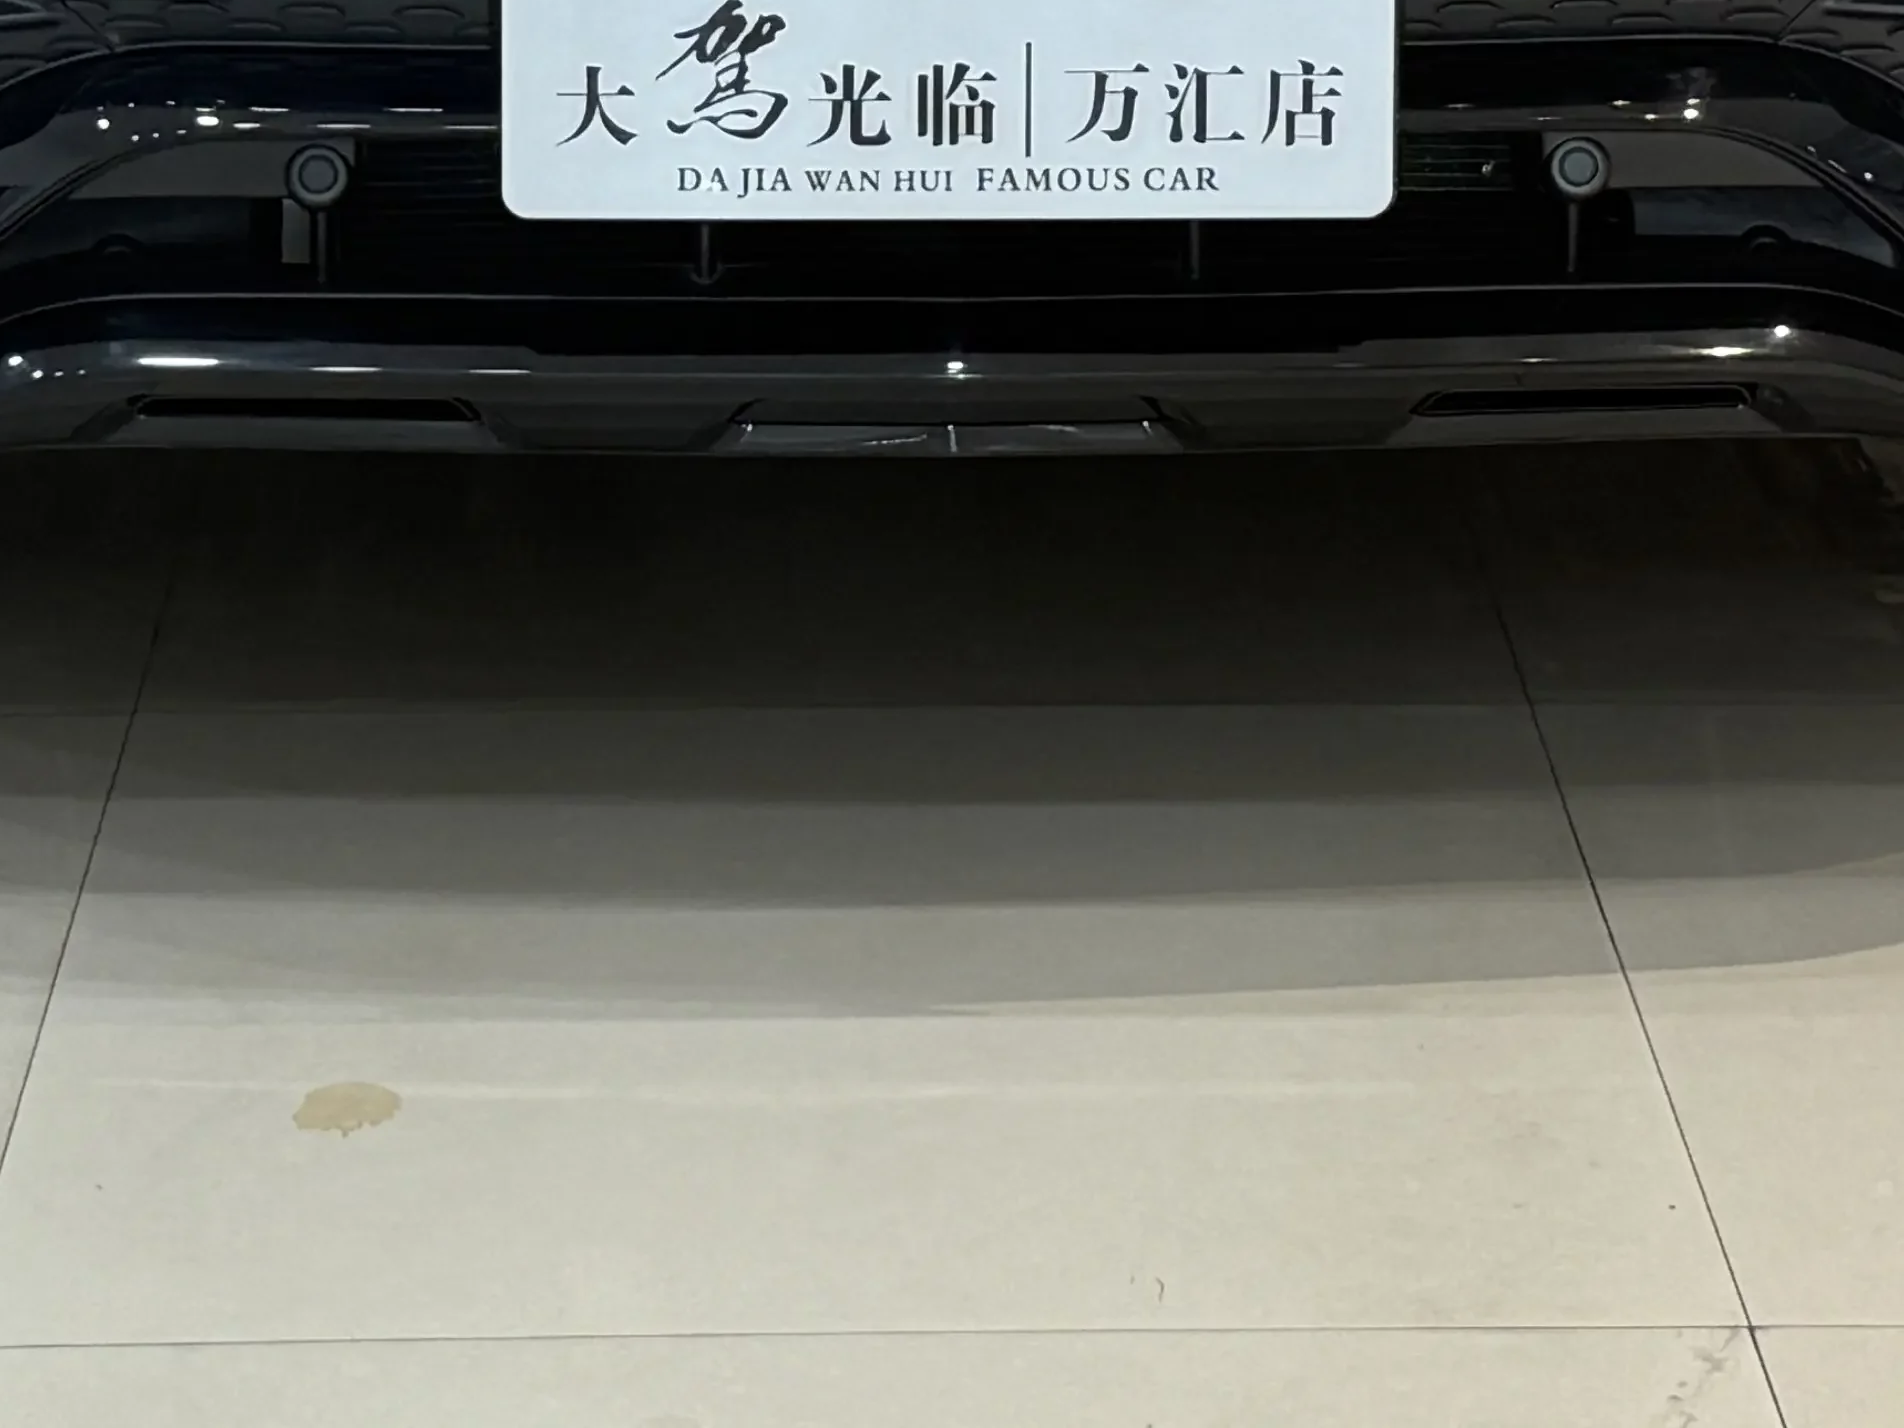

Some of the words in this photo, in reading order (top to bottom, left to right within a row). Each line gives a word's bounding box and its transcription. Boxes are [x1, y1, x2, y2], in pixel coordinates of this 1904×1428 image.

[558, 0, 996, 146] 大驾光临
[1068, 60, 1343, 146] 万汇店
[805, 171, 879, 191] WAN
[895, 171, 951, 191] HUI
[978, 168, 1129, 191] FAMOUS
[1144, 168, 1218, 190] CAR
